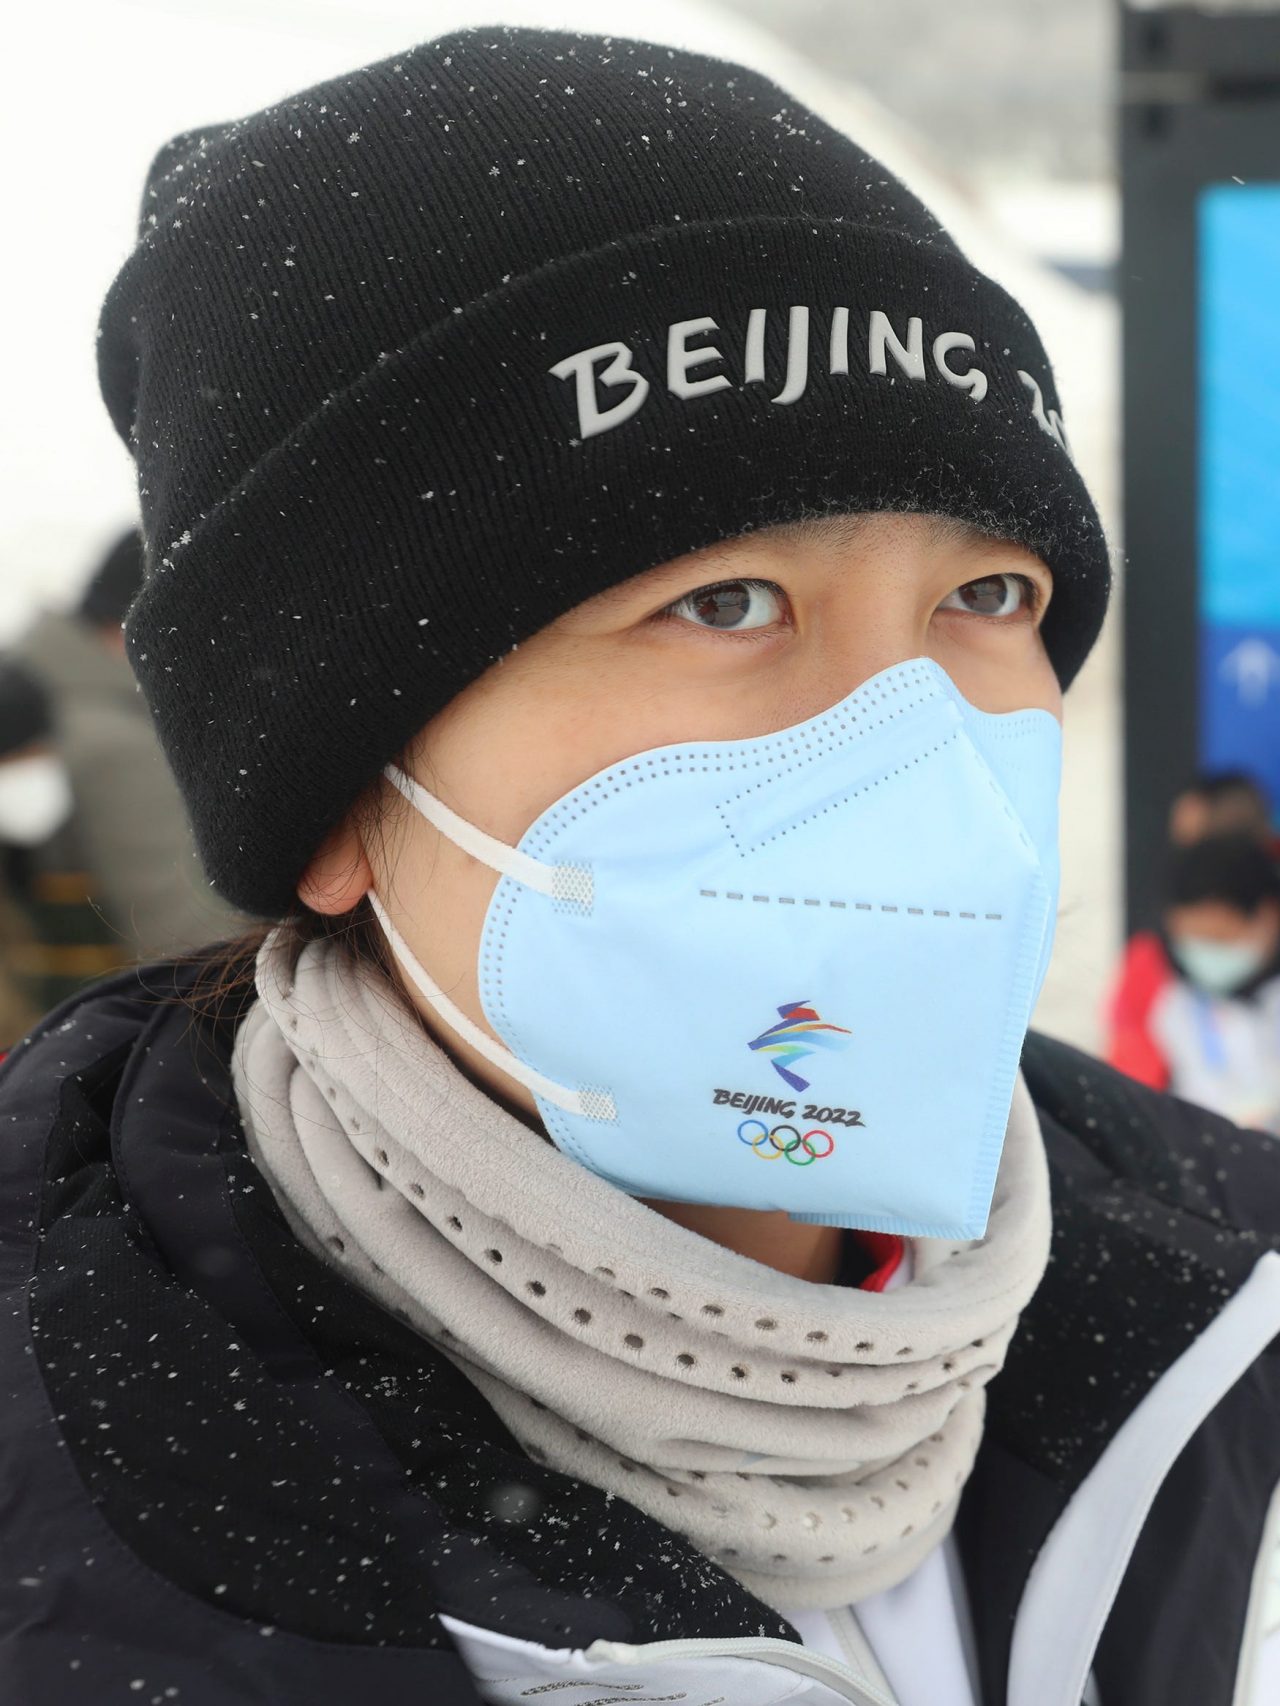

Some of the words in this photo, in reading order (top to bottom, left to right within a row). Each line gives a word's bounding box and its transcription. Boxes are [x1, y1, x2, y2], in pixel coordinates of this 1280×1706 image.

[549, 305, 988, 439] BEIJING
[712, 1088, 797, 1119] BEIJING
[802, 1104, 866, 1128] 2022
